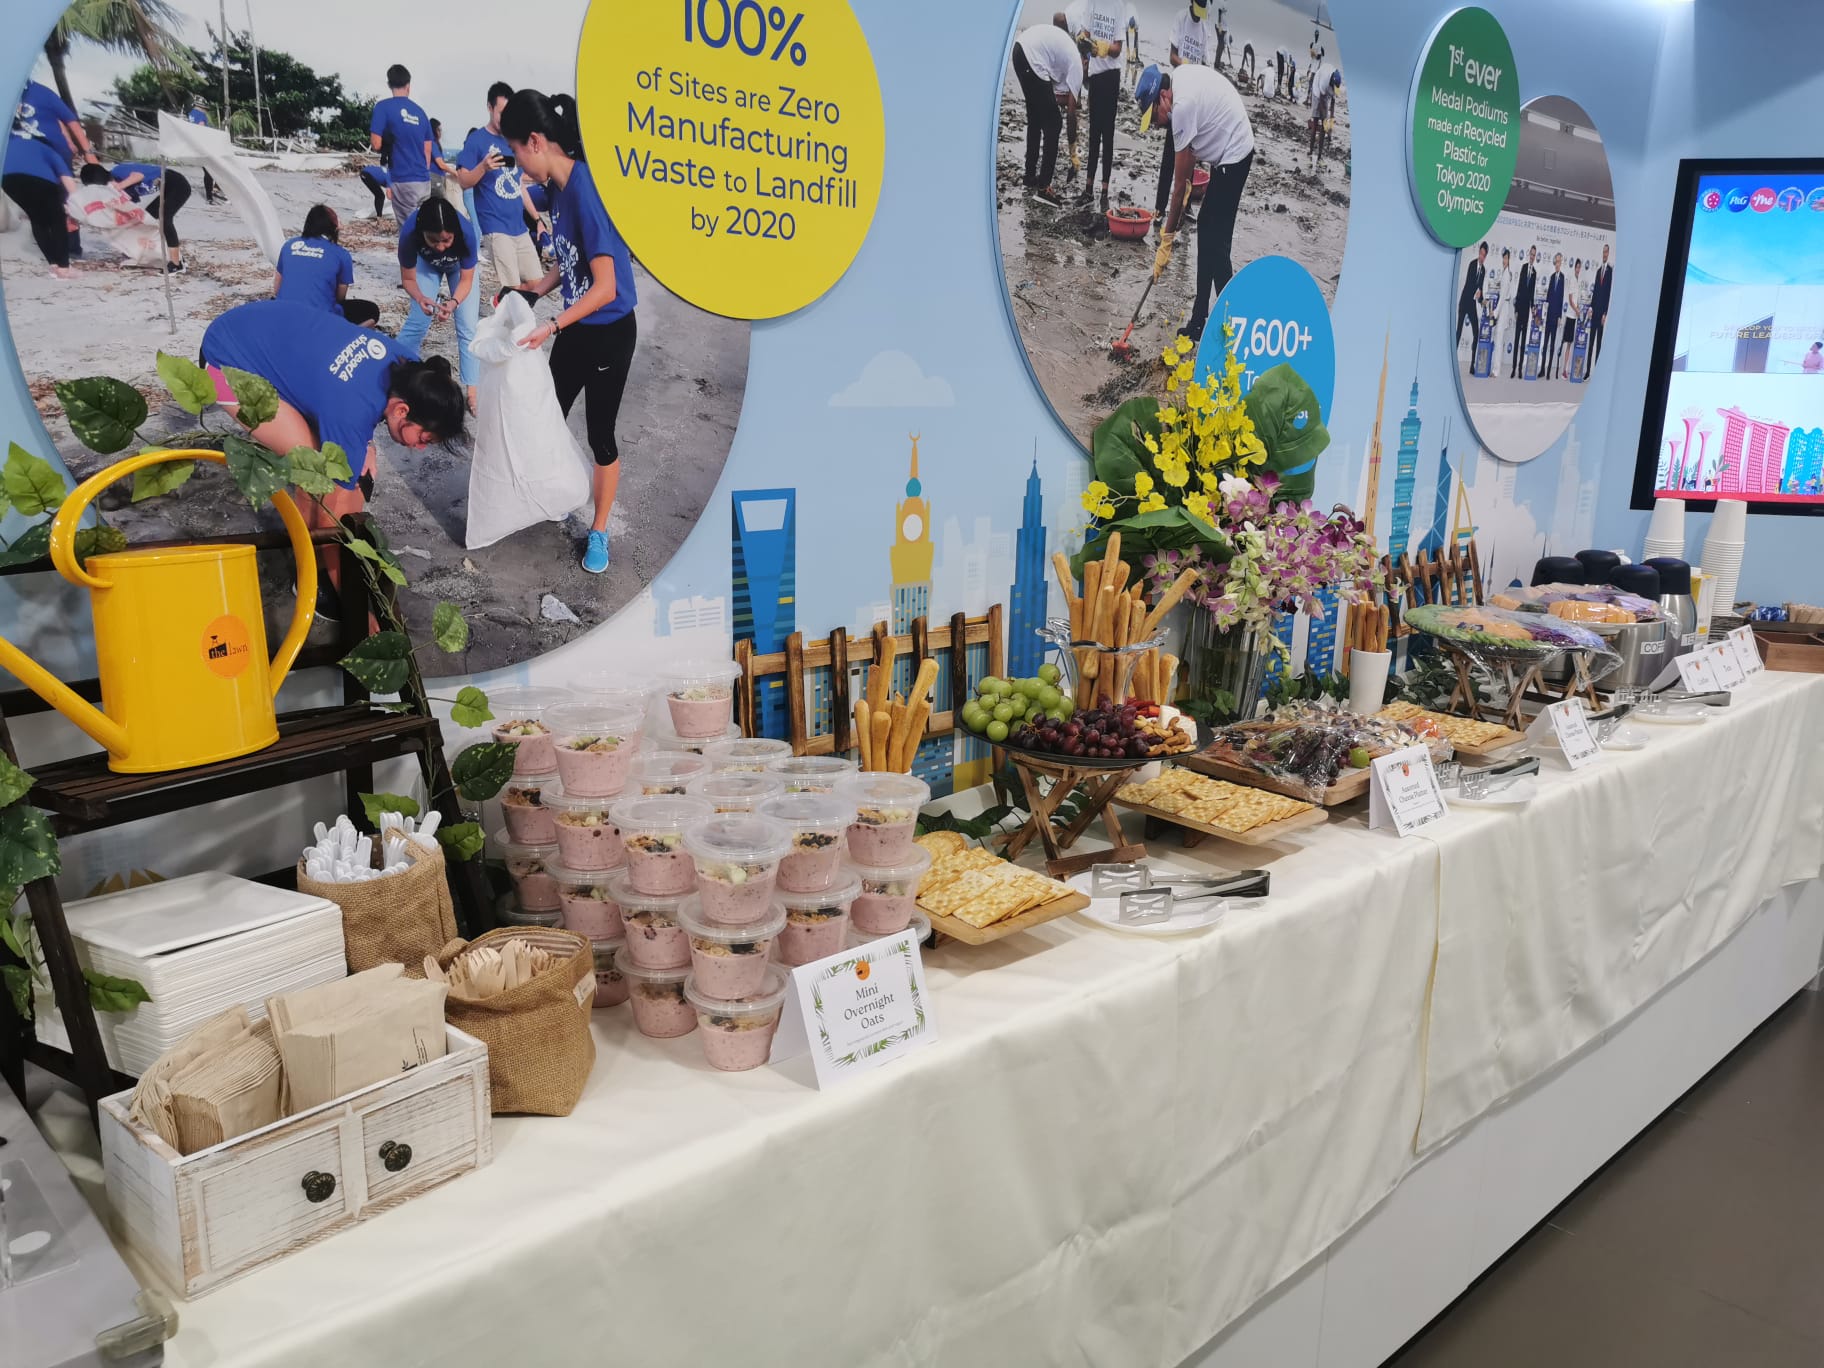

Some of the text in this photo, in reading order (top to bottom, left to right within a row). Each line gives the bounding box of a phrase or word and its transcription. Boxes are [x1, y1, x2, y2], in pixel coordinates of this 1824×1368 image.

[684, 0, 807, 66] 100%
[1465, 59, 1502, 91] ever
[636, 67, 840, 124] of Sites are Zero
[1431, 86, 1509, 125] Medal Podiums
[628, 101, 848, 173] Manufacturing
[1428, 116, 1507, 149] made of Recycled
[1443, 141, 1489, 167] Plastic for
[614, 145, 857, 208] Waste to Landfill
[1436, 164, 1491, 192] Tokyo 2020
[1437, 190, 1485, 216] Olympics
[691, 205, 796, 240] by 2020
[329, 334, 368, 375] shoulders
[1231, 316, 1312, 360] 7,600+
[843, 994, 895, 1021] Overnight
[855, 983, 879, 1001] Mini
[861, 1013, 885, 1029] Oats
